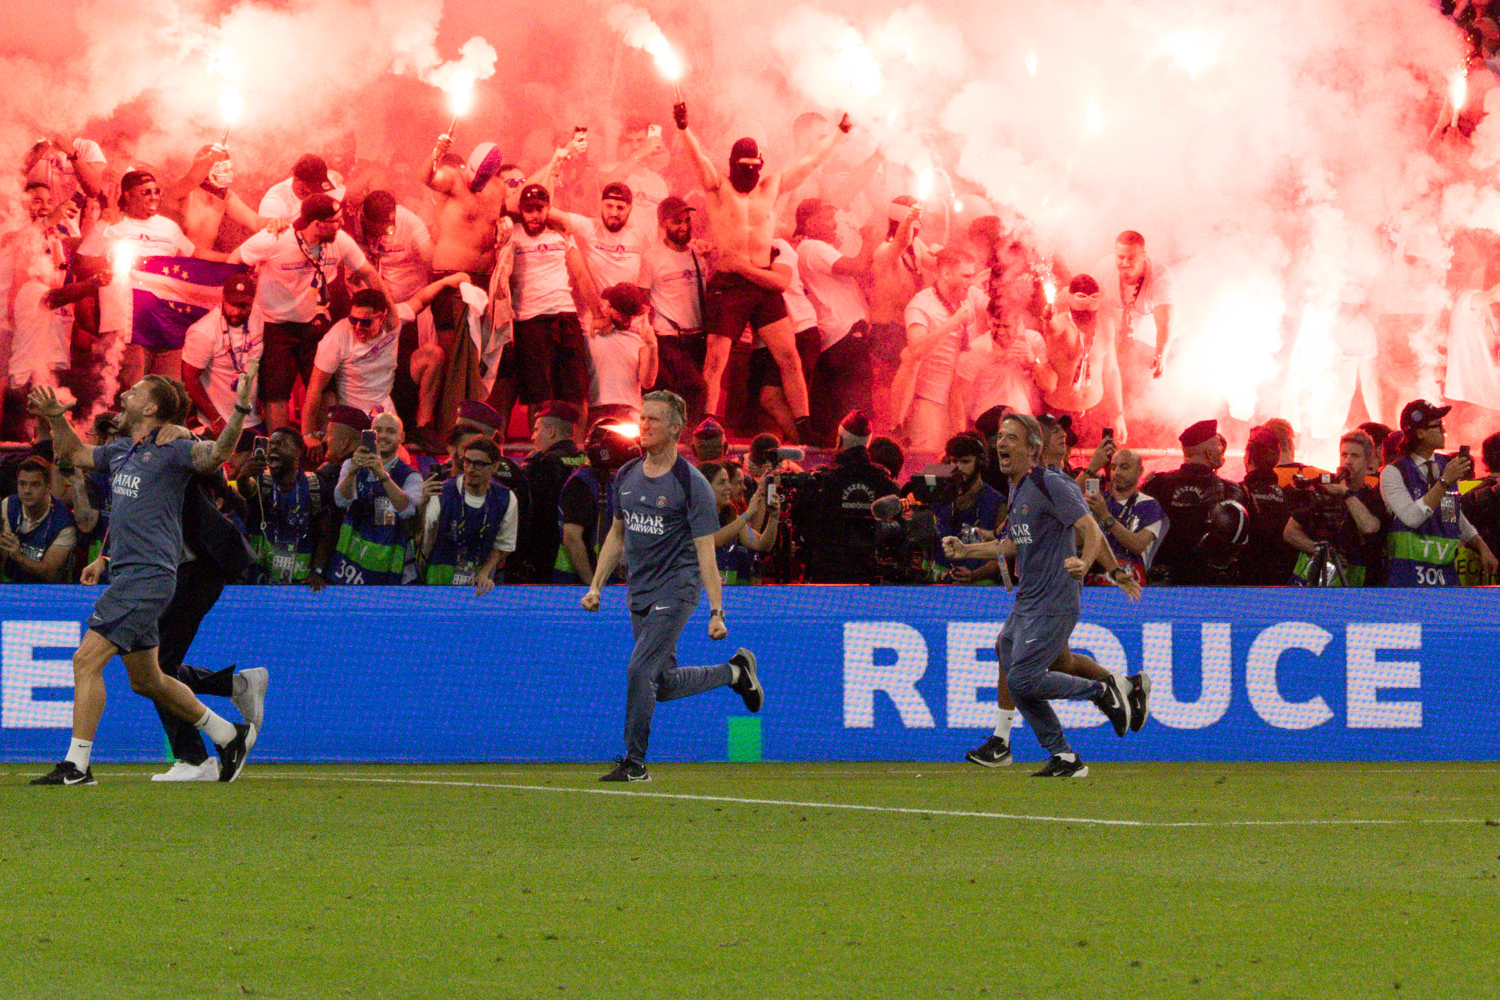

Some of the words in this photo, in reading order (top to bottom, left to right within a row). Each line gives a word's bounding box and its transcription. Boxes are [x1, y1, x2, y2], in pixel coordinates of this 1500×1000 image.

[622, 509, 665, 528] QATAR
[629, 523, 665, 536] AIRWAYS
[1421, 540, 1449, 561] TV
